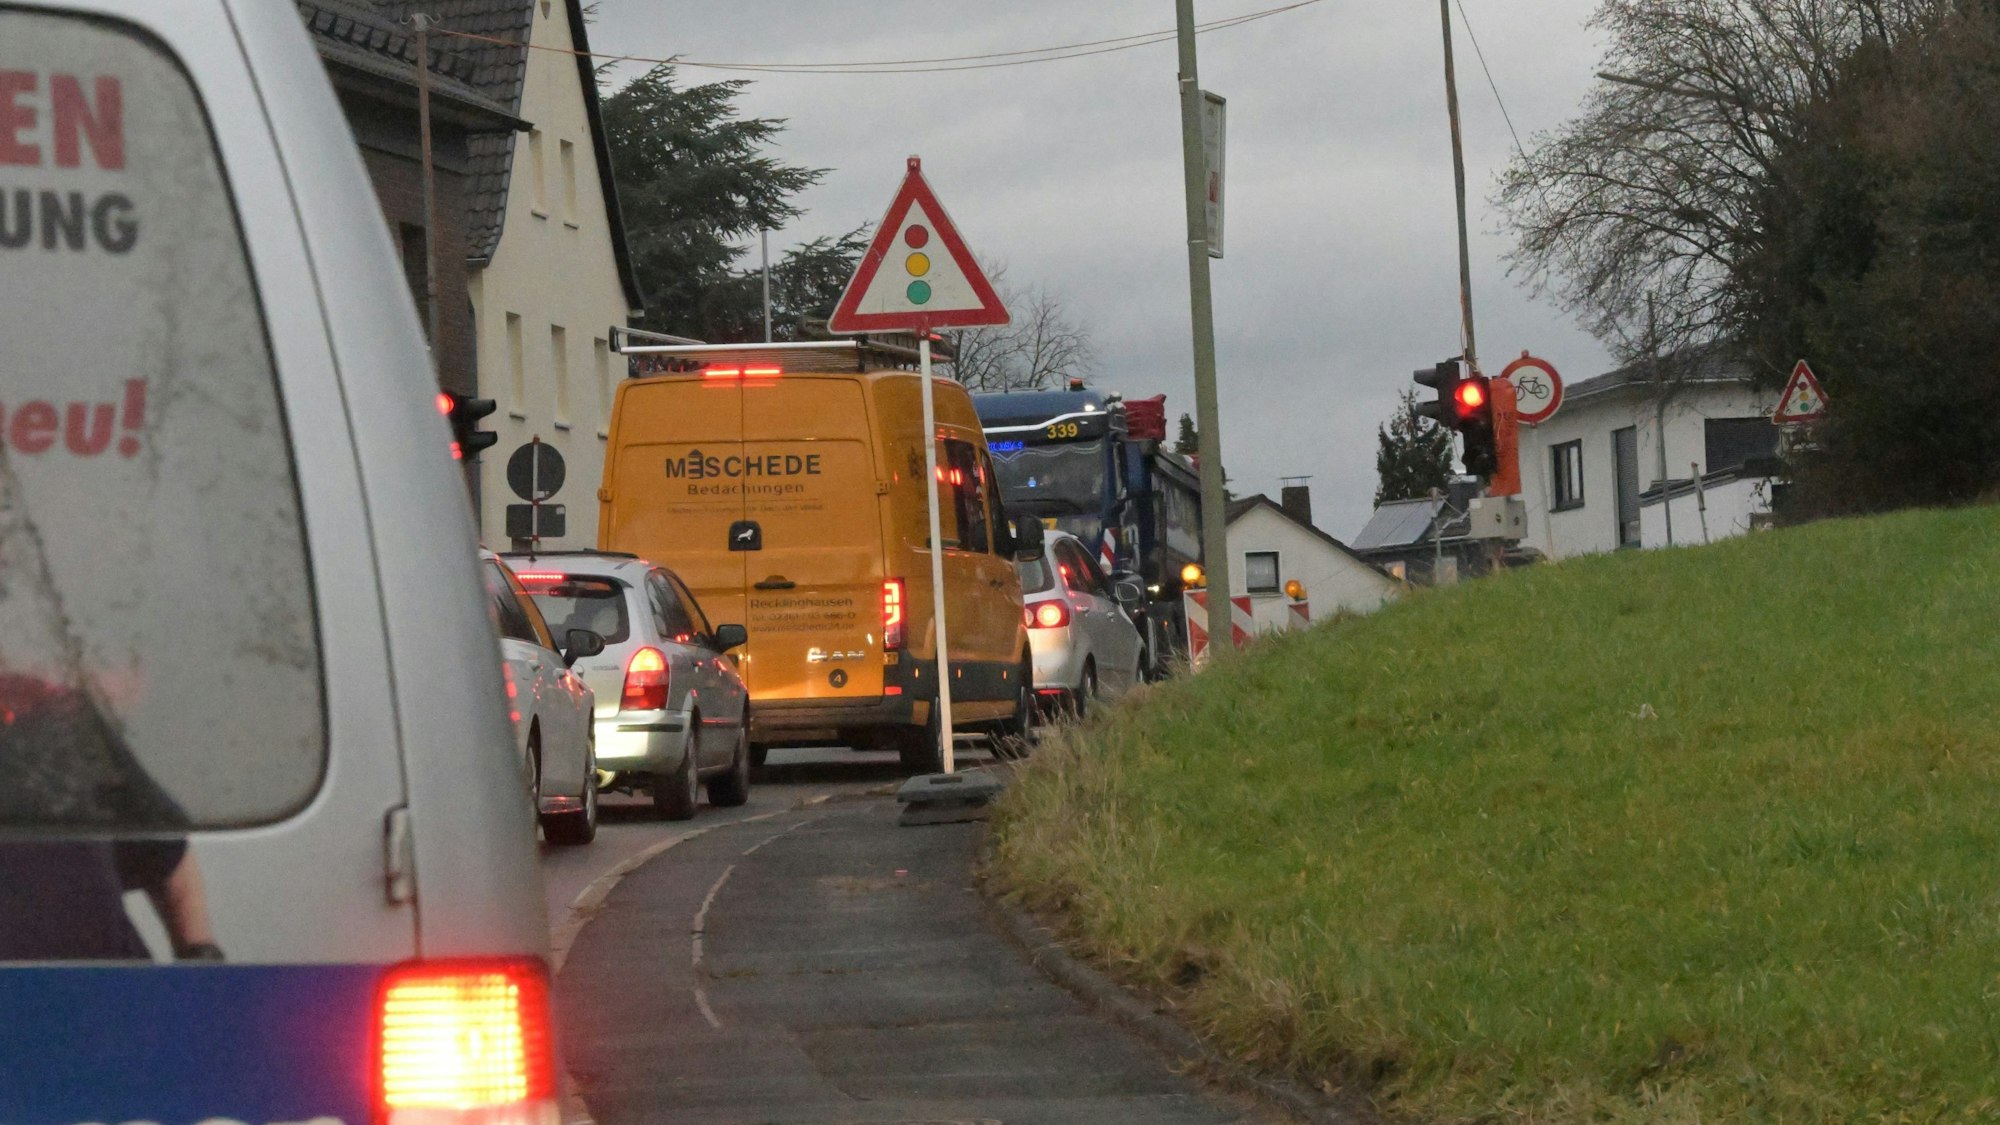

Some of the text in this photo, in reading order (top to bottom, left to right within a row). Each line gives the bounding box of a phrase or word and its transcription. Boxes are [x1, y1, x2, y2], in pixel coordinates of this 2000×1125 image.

[0, 378, 149, 459] eu!
[1047, 423, 1078, 439] 339
[687, 483, 805, 496] Bedachungen
[750, 598, 853, 609] Recklinghausen
